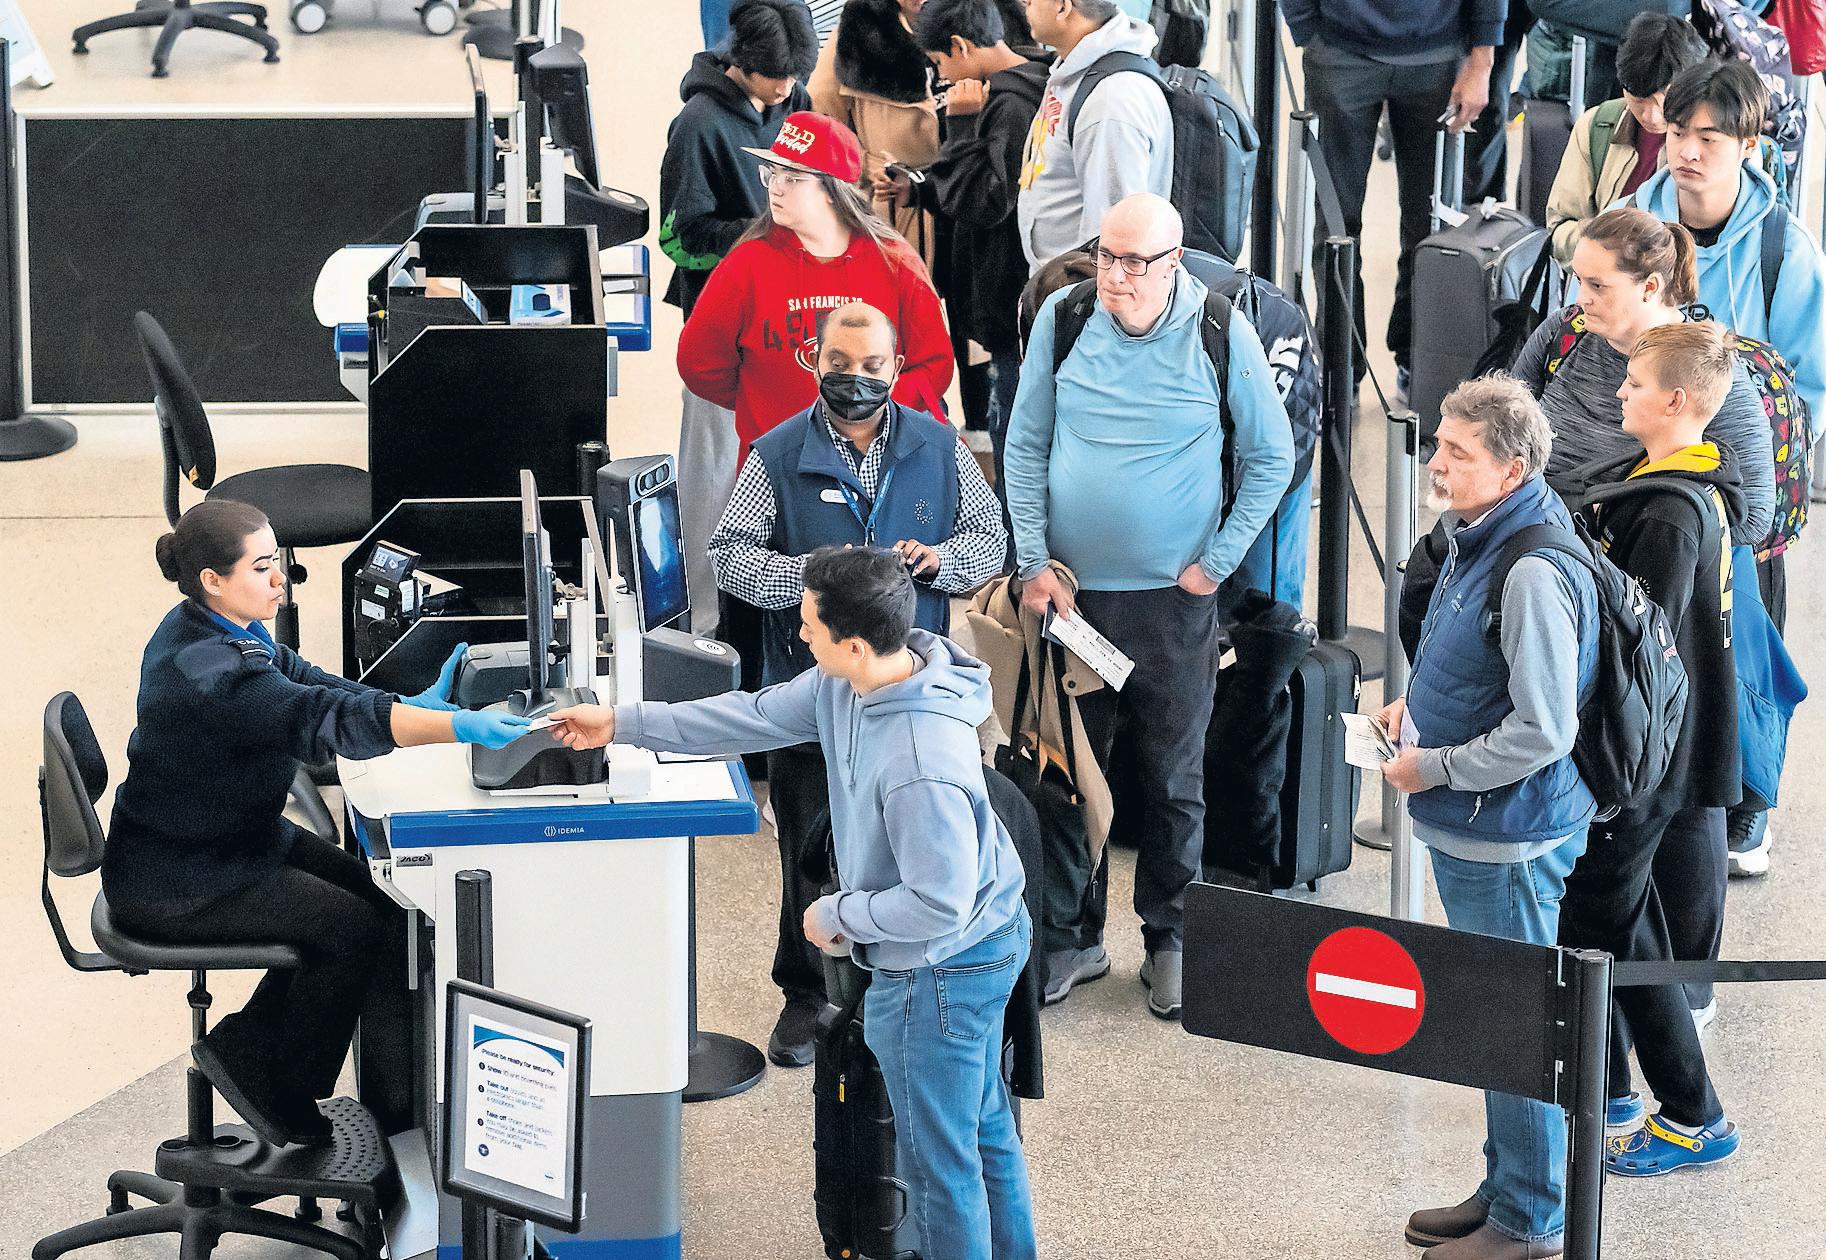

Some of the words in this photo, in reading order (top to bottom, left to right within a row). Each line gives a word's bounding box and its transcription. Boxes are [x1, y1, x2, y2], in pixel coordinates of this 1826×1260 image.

[558, 827, 585, 835] IDEMIA
[487, 1065, 501, 1074] Show
[487, 1080, 498, 1088] Take
[500, 1084, 508, 1092] out
[486, 1110, 497, 1119] Take
